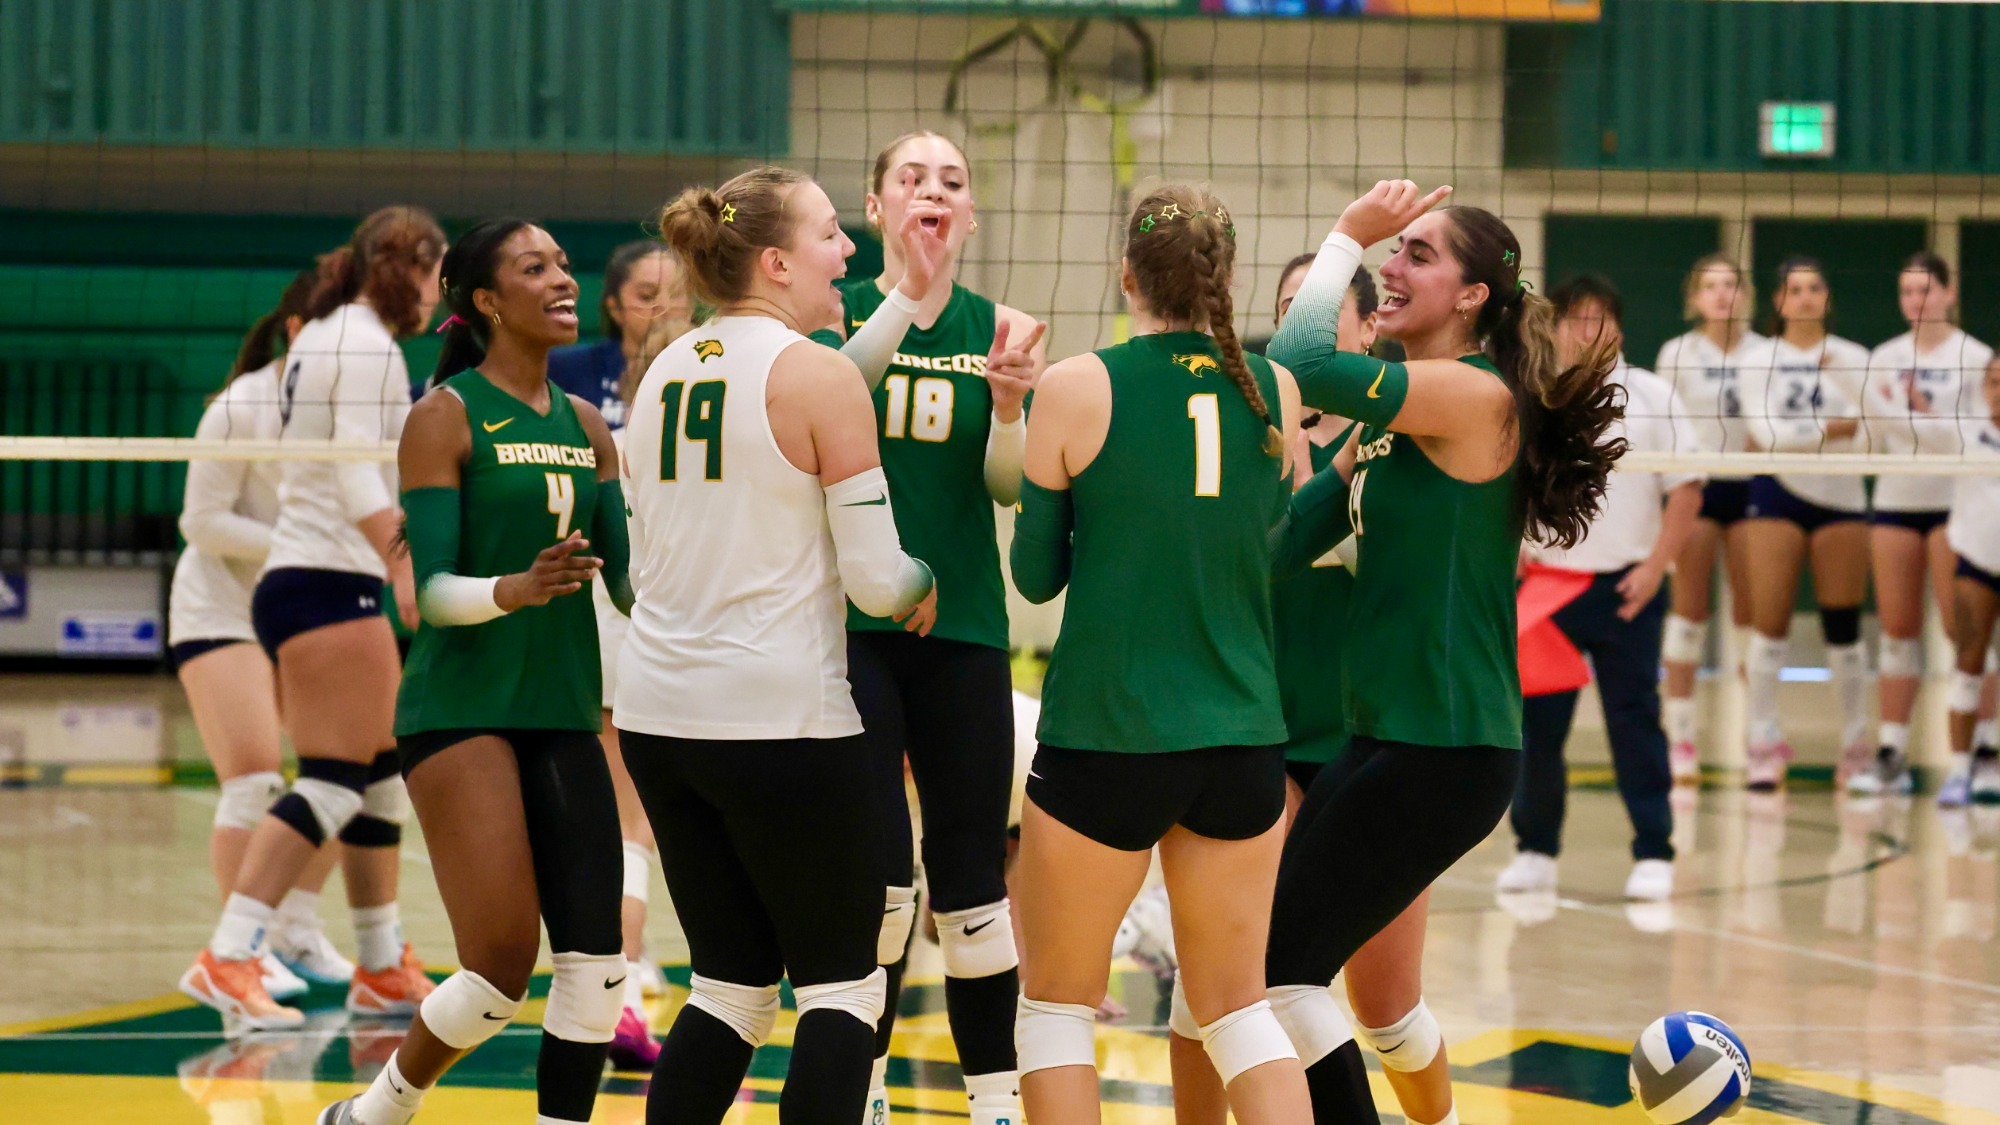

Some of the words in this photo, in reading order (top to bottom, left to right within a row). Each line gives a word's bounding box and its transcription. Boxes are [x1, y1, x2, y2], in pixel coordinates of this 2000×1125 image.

[891, 352, 988, 377] ONCOS
[659, 377, 728, 483] 19
[885, 373, 954, 443] 18
[1187, 393, 1221, 497] 1
[544, 472, 575, 539] 4
[1705, 1028, 1751, 1082] molten
